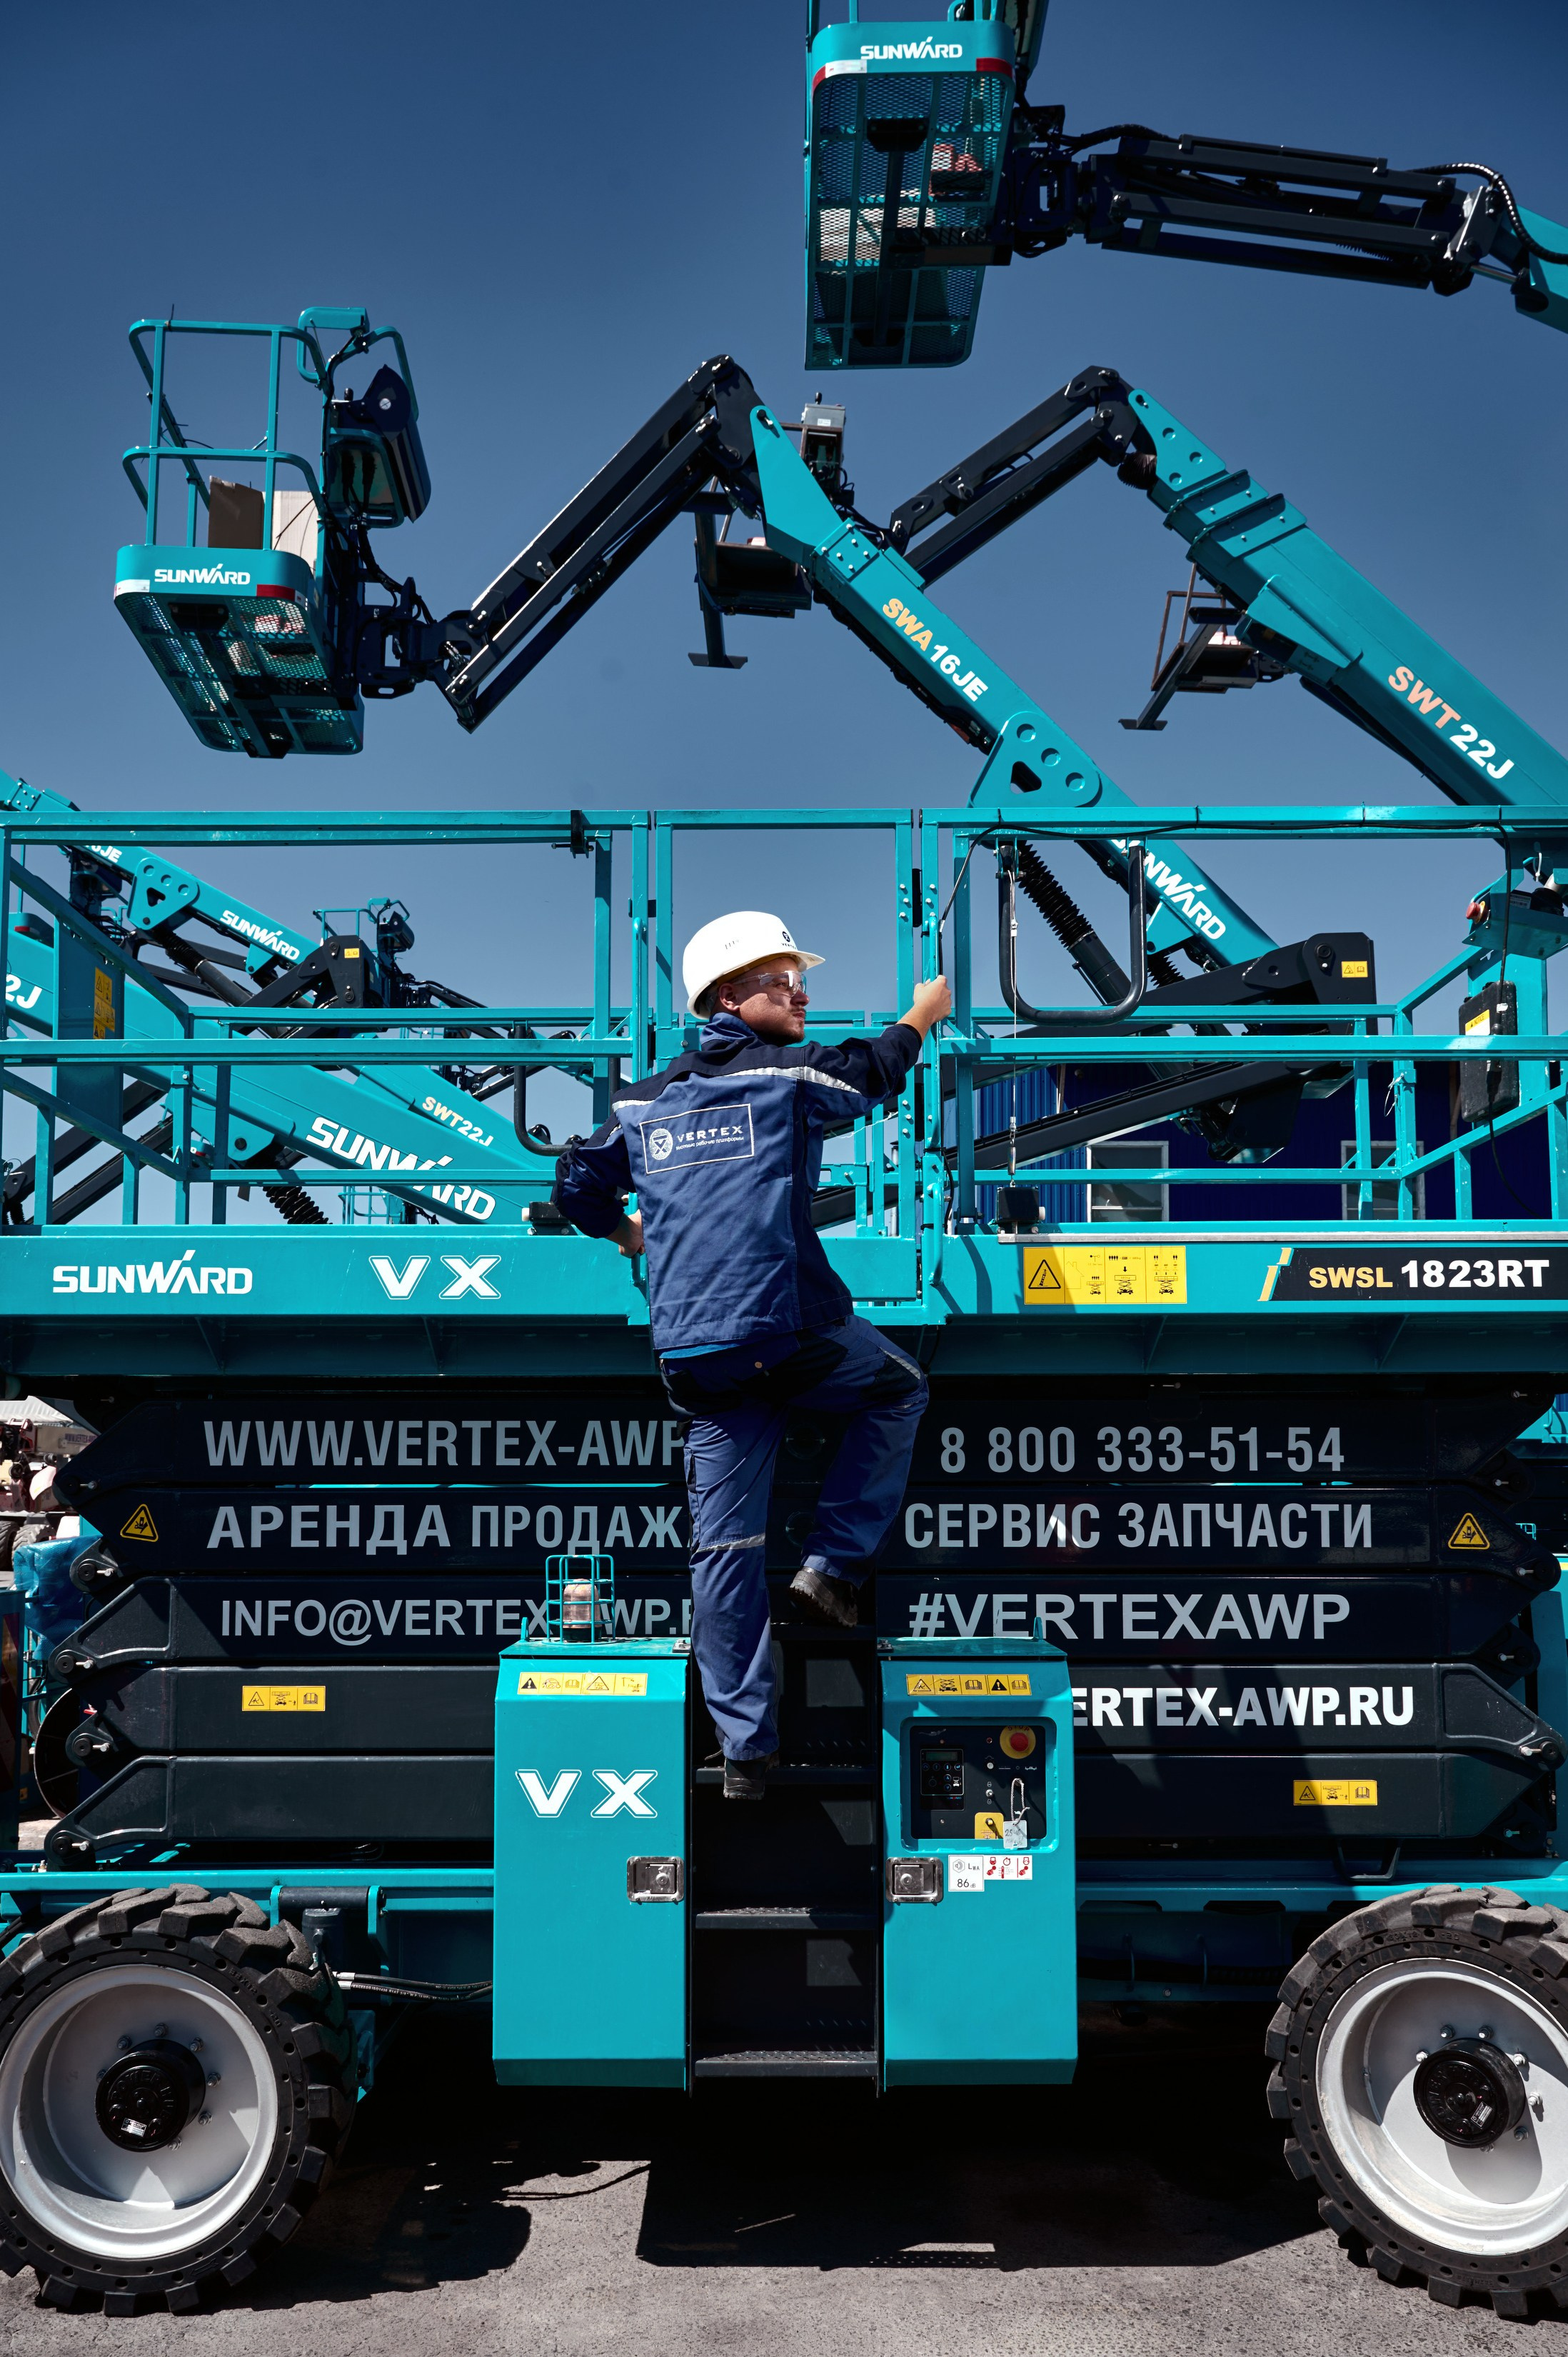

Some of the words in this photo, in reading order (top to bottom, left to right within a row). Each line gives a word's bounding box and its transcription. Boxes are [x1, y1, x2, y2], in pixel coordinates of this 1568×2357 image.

[860, 36, 963, 59] SUNWARD
[154, 563, 251, 585] SUNWARD
[220, 910, 300, 961] SUNWARD
[677, 1126, 743, 1141] VERTEX
[53, 1249, 253, 1294] SUNWARD
[1309, 1266, 1393, 1288] SWSL
[1401, 1259, 1549, 1288] 1823RT
[940, 1427, 965, 1473] 8
[988, 1426, 1075, 1473] 800
[1097, 1426, 1345, 1473] 333-51-54
[206, 1504, 451, 1556] АРЕНДА
[471, 1505, 690, 1554] ПРОДАЖ
[905, 1503, 1100, 1548] СЕРВИС
[1117, 1502, 1372, 1548] ЗАПЧАСТИ
[909, 1593, 1350, 1640] #VERTEXAWP
[957, 1878, 970, 1888] 86
